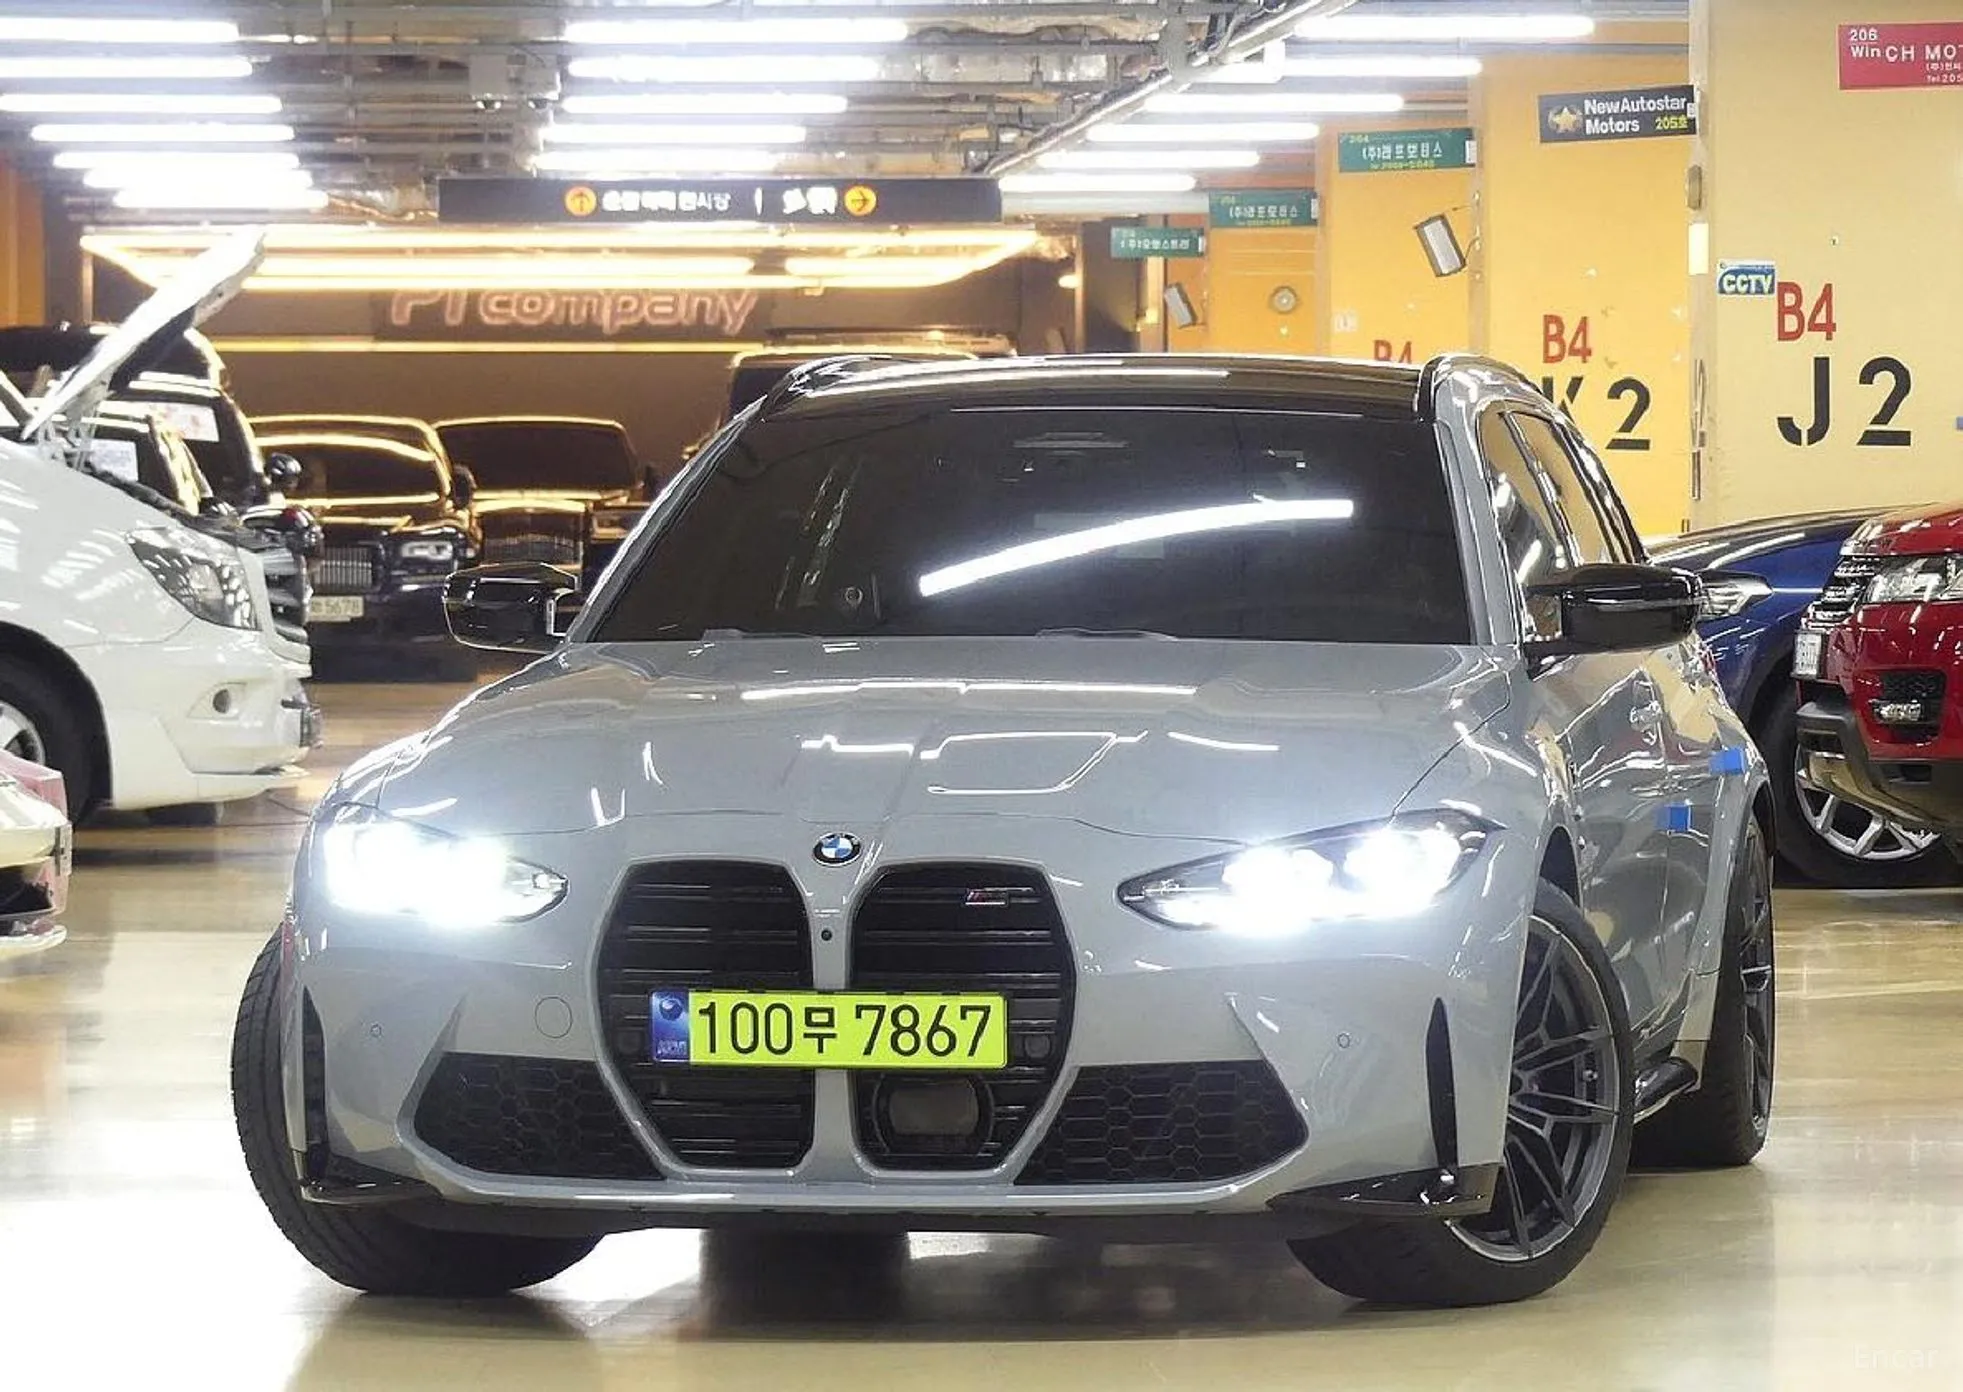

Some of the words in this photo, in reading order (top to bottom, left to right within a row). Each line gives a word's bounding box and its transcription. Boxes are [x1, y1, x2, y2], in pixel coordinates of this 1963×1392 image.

[1849, 28, 1878, 41] 206
[1850, 44, 1881, 58] Win
[1925, 43, 1963, 60] MO
[1586, 118, 1640, 135] Motors
[1723, 274, 1773, 294] CCTV
[1777, 282, 1836, 341] B4
[1542, 314, 1593, 364] B4
[698, 1001, 837, 1055] 100무
[855, 1004, 993, 1058] 7867
